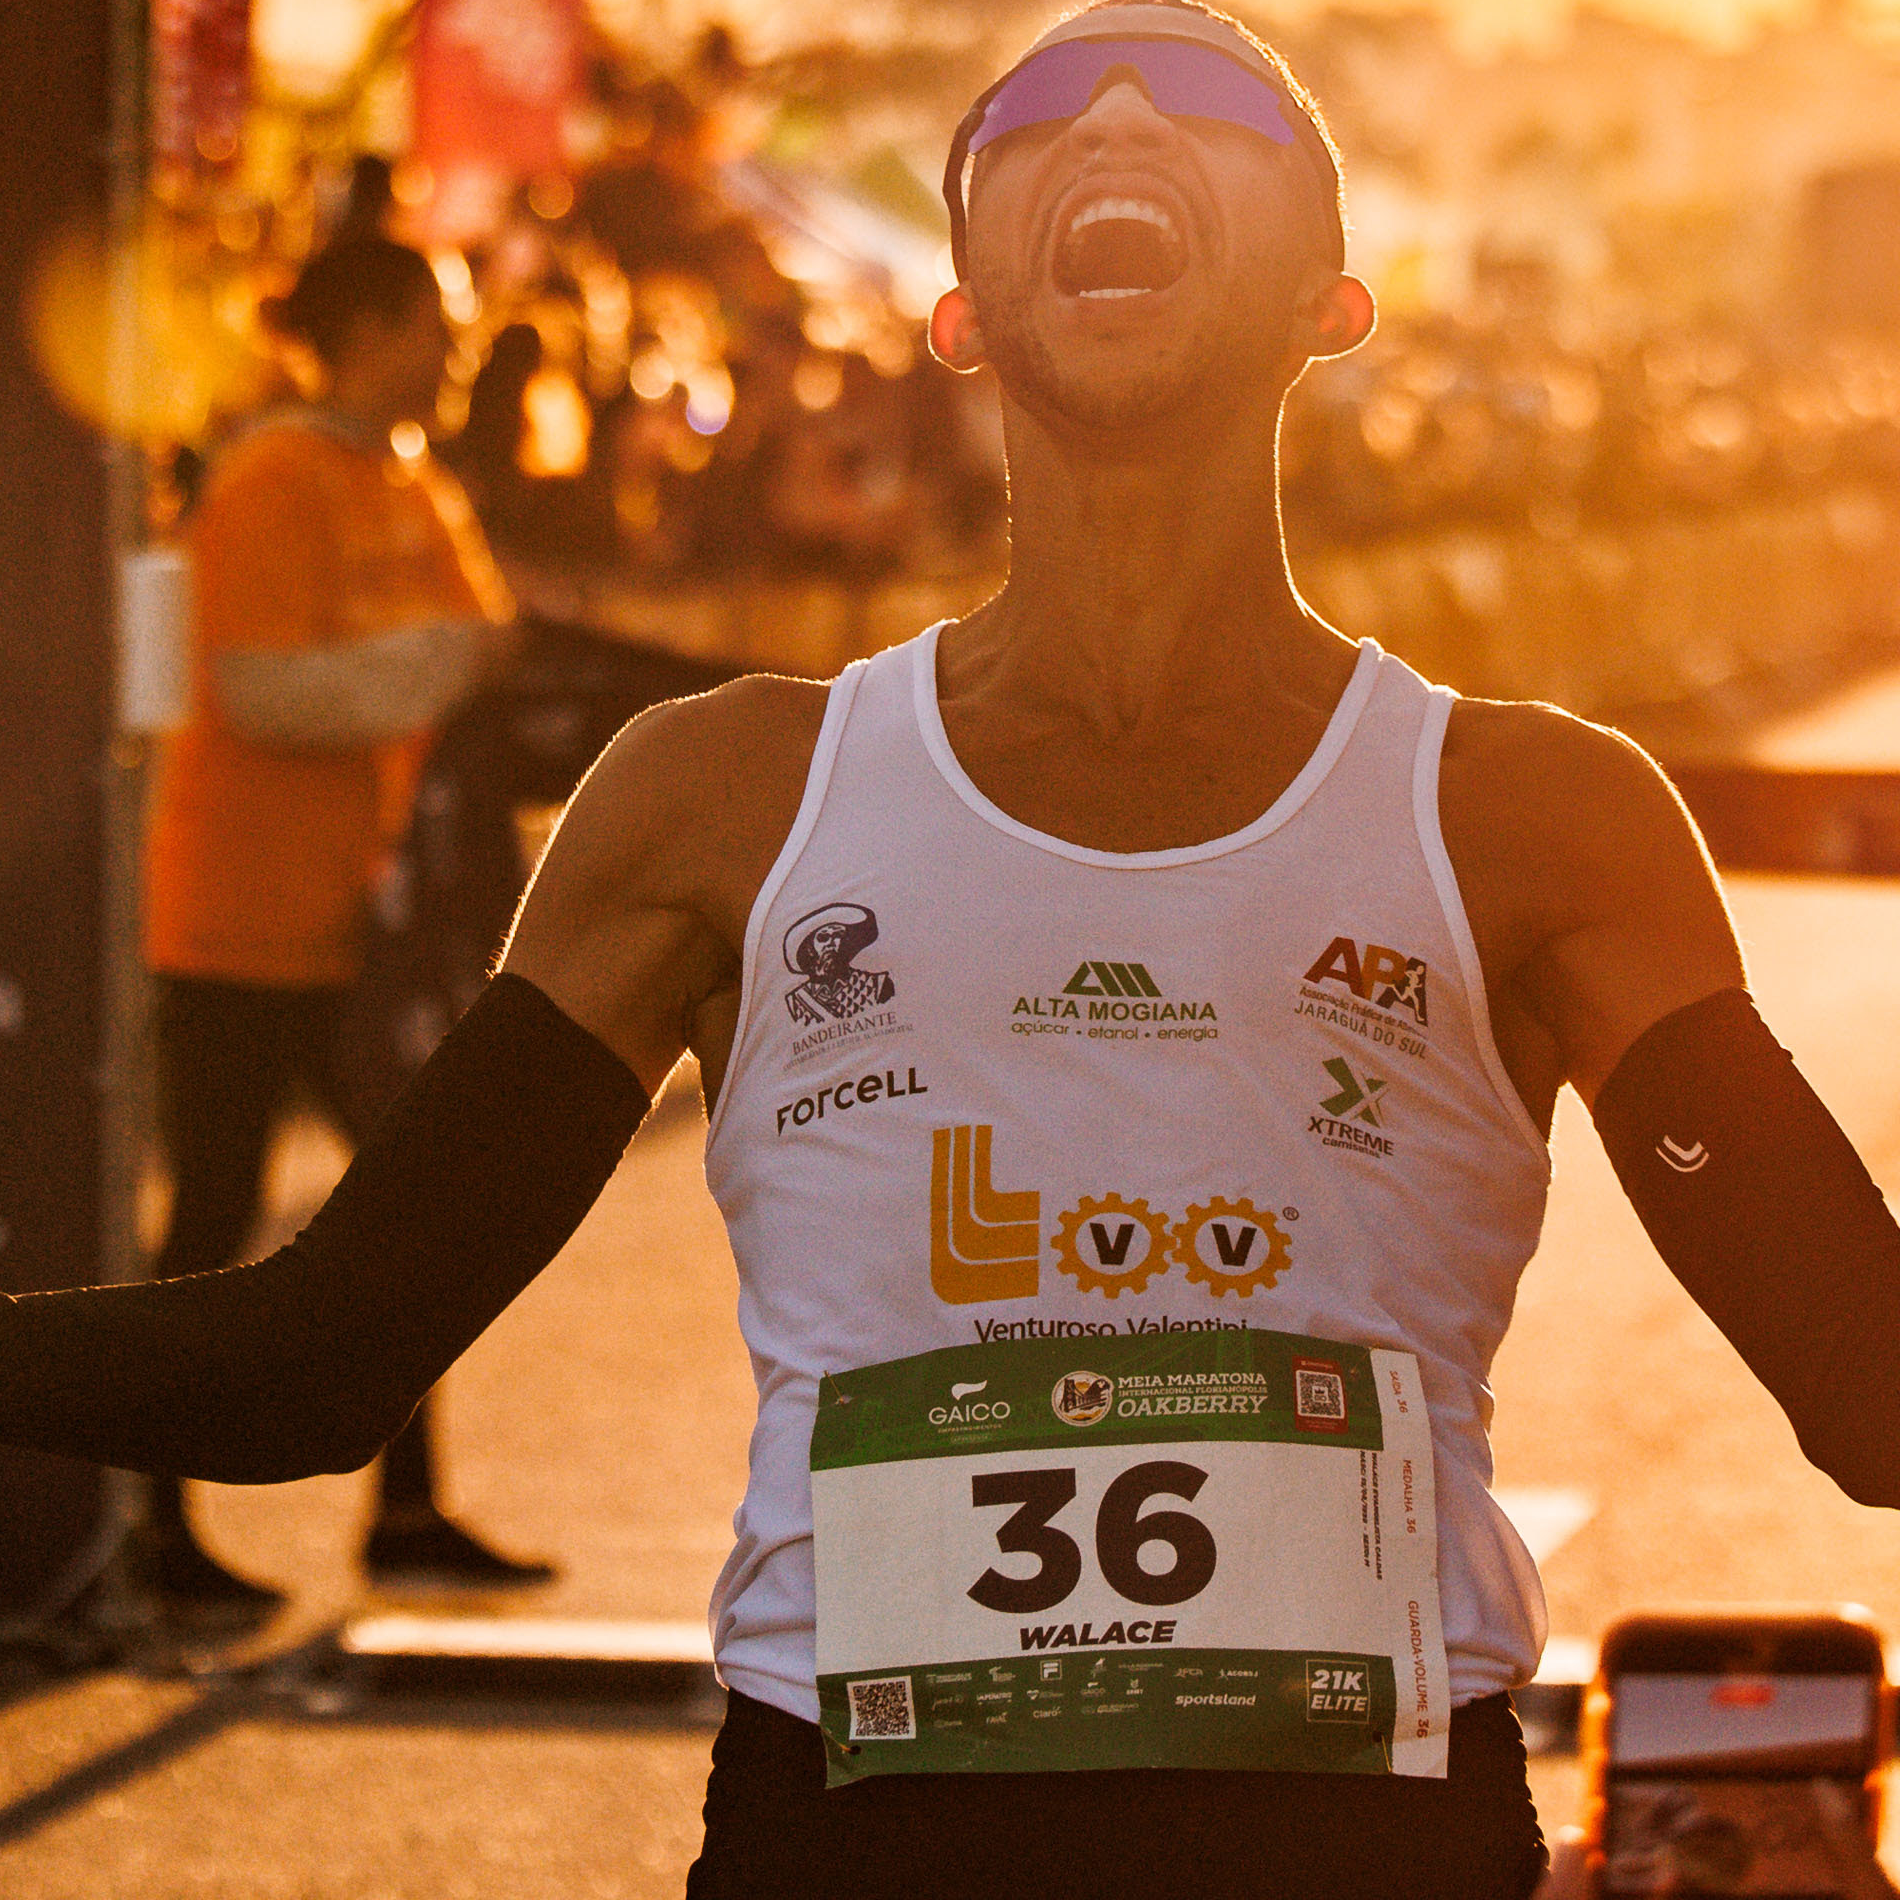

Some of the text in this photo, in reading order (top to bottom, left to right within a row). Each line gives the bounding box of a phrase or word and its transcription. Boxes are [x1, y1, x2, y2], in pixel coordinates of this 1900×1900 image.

[1012, 996, 1217, 1021] ALTA MOGIANA
[792, 1011, 898, 1056] BANDEIRANTE
[1011, 1019, 1218, 1042] açúcar etanol energia
[1294, 1000, 1369, 1038] JARAGUÁ
[1372, 1026, 1395, 1046] DO
[1398, 1036, 1428, 1060] SUL
[1307, 1116, 1395, 1157] XTREME
[975, 1315, 1248, 1344] Venturoso Valentini
[1118, 1372, 1268, 1388] MEIA MARATONA
[1118, 1385, 1268, 1398] INTERNACIONAL FLORIANÓPOLIS
[1389, 1370, 1409, 1414] SAÍDA 36
[928, 1401, 1011, 1425] GAICO
[1117, 1395, 1268, 1418] OAKBERRY
[1402, 1459, 1417, 1534] MEDALHA 36
[966, 1460, 1217, 1614] 36
[1019, 1620, 1177, 1652] WALACE
[1311, 1669, 1364, 1691] 21K
[1407, 1600, 1430, 1739] GUARDA-VOLUME 36
[1175, 1692, 1257, 1708] sportsland
[1310, 1693, 1368, 1713] ELITE
